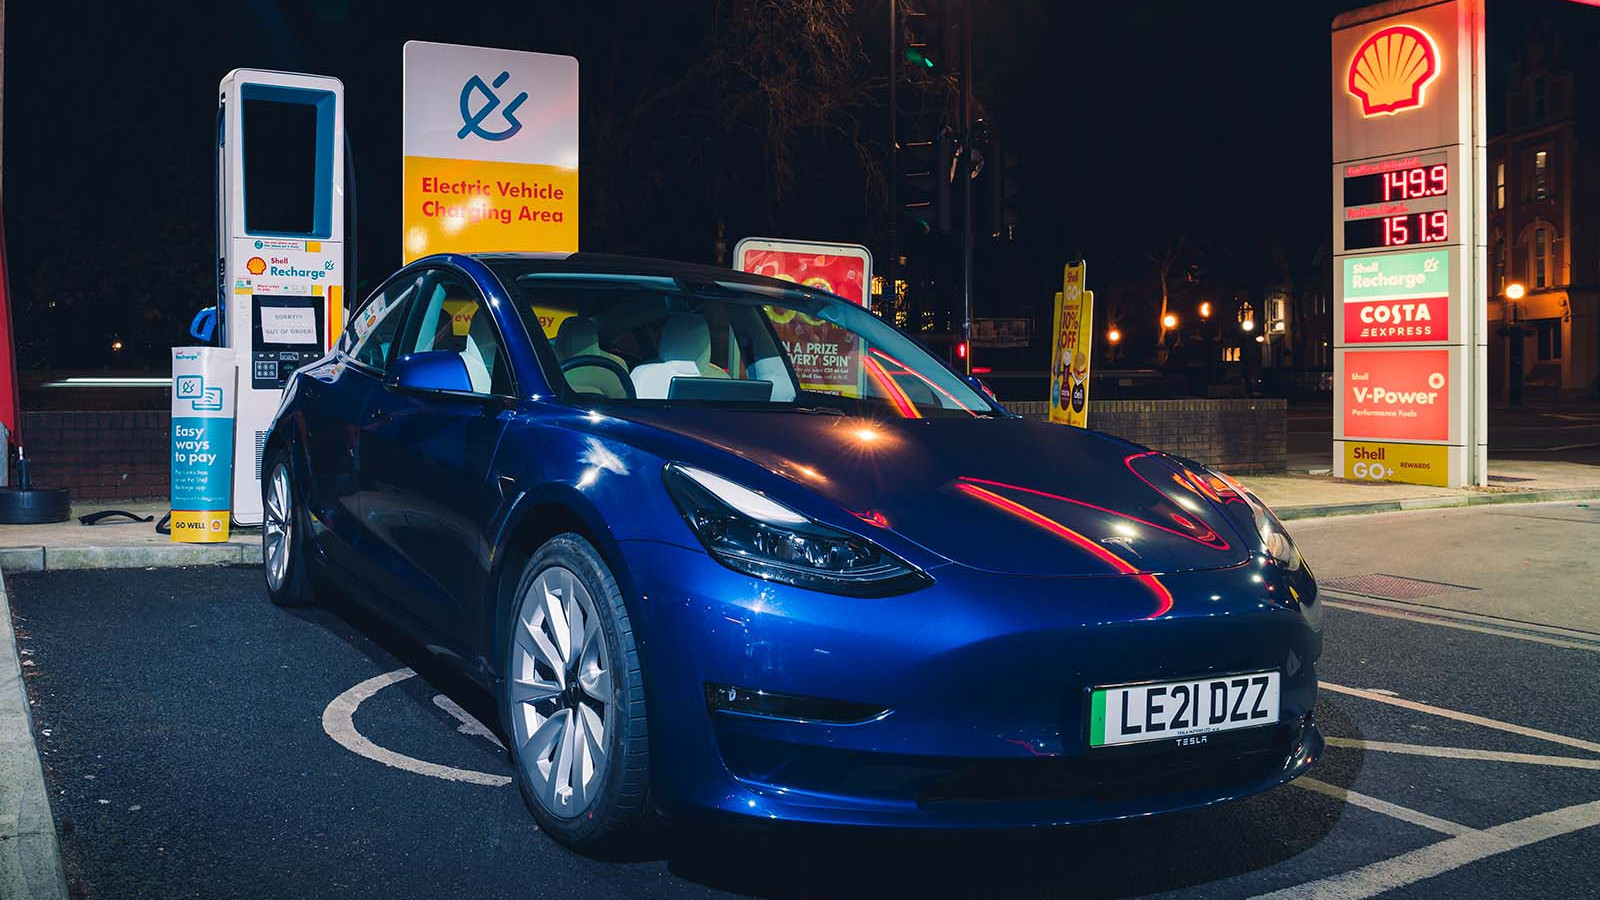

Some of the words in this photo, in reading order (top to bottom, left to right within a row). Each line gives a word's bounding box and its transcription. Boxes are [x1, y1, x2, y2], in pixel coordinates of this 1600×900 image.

[422, 177, 491, 196] Electric
[497, 181, 564, 200] Vehicle
[1383, 165, 1447, 201] 149.9
[422, 201, 512, 224] Charging
[518, 206, 563, 223] Area
[270, 257, 289, 265] Shell
[1352, 261, 1379, 274] Shell
[270, 267, 326, 280] Recharge
[1067, 269, 1078, 283] Shell
[1352, 272, 1426, 289] Recharge
[1062, 311, 1078, 330] 10%
[1360, 303, 1431, 325] COSTA
[1371, 326, 1432, 337] EXPRESS
[1061, 331, 1076, 349] OFF
[794, 343, 803, 353] A
[806, 343, 839, 355] PRIZE
[1351, 373, 1369, 381] Shell
[1353, 387, 1438, 404] V-Power
[1352, 408, 1397, 417] Performance
[1398, 409, 1417, 418] Fuels
[175, 425, 205, 440] Easy
[175, 441, 210, 453] ways
[1353, 446, 1385, 460] Shell
[175, 451, 186, 462] to
[189, 453, 217, 466] pay
[1353, 462, 1394, 479] GO+
[1400, 461, 1431, 470] REWARDS
[175, 521, 186, 529] GO
[187, 521, 206, 529] WELL
[1121, 683, 1199, 735] LE21
[1209, 676, 1269, 725] DZZ
[1176, 735, 1208, 747] TESLA
